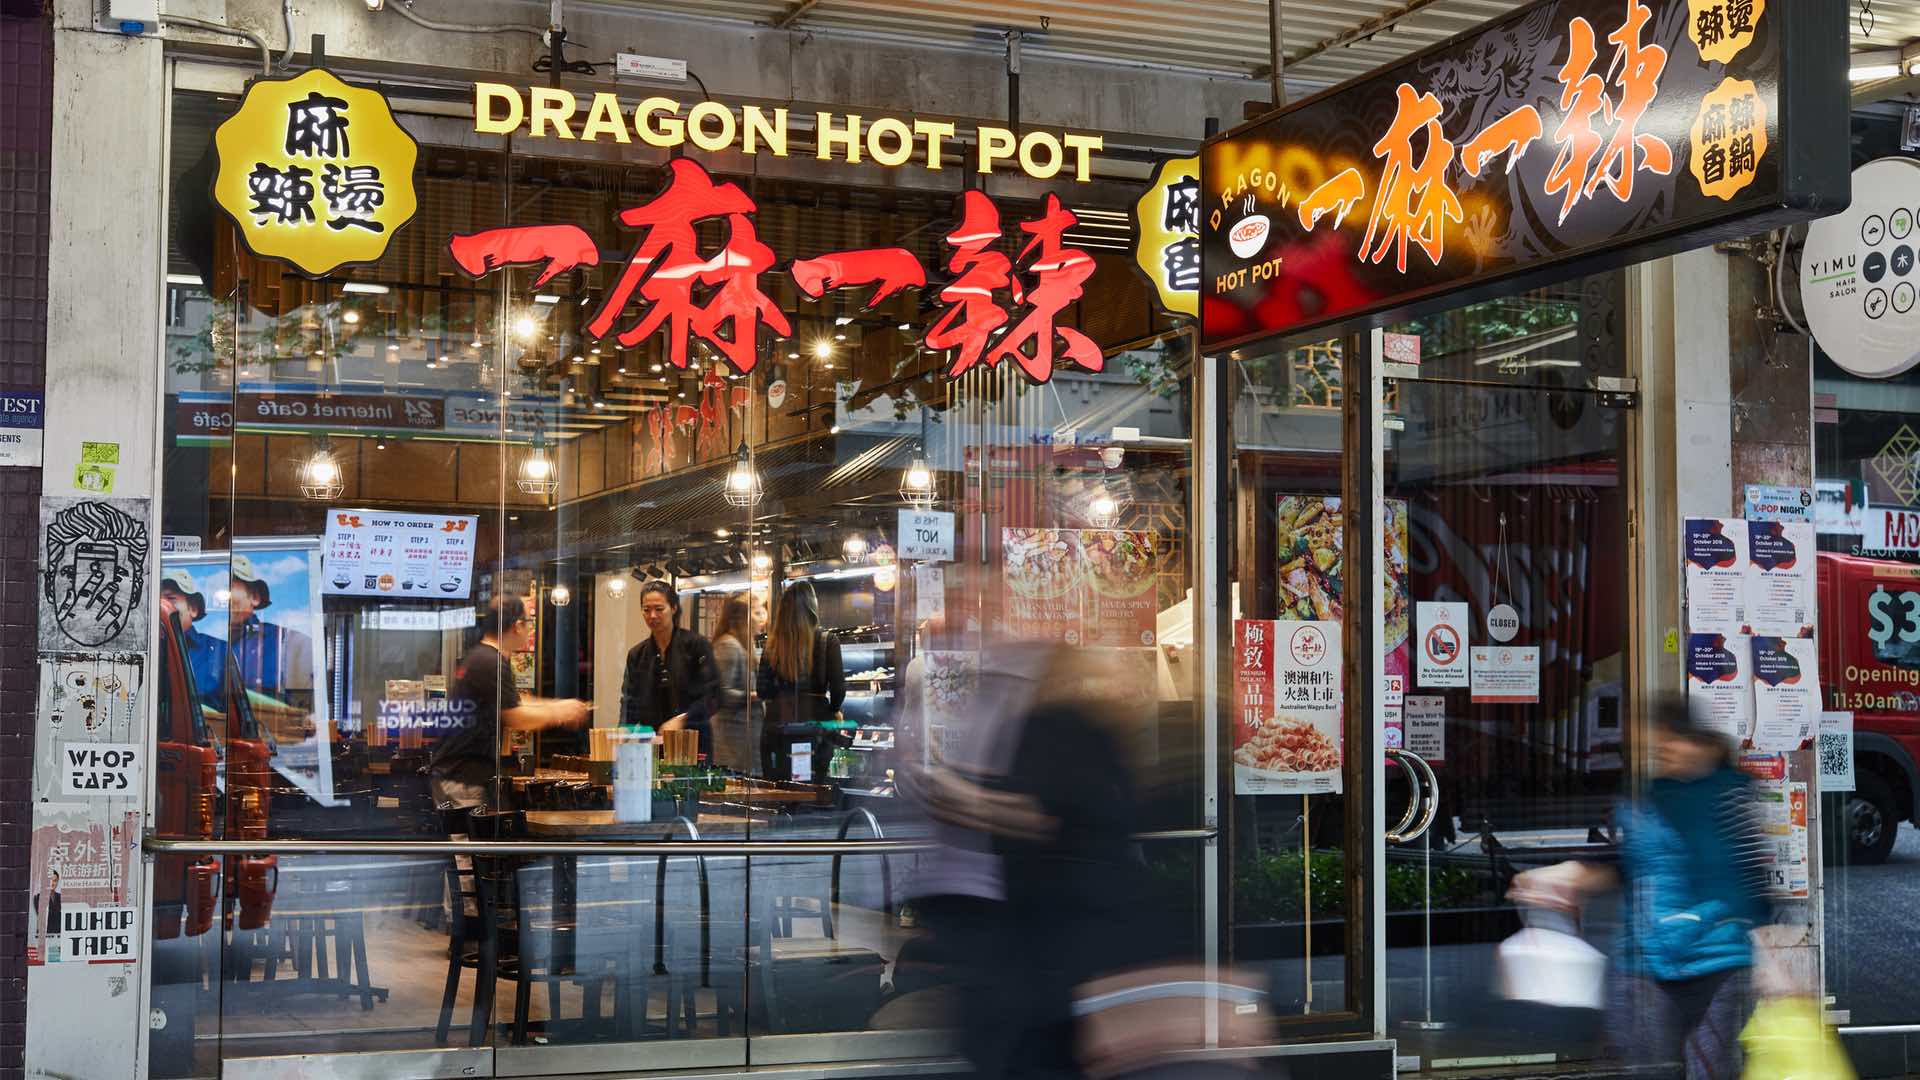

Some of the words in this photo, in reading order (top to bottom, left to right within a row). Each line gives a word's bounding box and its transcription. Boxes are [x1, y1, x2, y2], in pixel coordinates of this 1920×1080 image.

[285, 92, 349, 159] 麻
[474, 82, 787, 157] DRAGON
[816, 112, 955, 170] HOT
[977, 126, 1103, 183] POT
[1297, 0, 1674, 275] 一麻一辣
[1209, 168, 1291, 231] DRAGON
[450, 157, 1104, 384] 一麻一辣
[1811, 254, 1856, 276] YIMU
[1216, 268, 1247, 294] HOT
[1252, 258, 1283, 283] POT
[1836, 278, 1856, 288] HAIR
[1829, 287, 1857, 299] SALON
[0, 397, 40, 413] EST
[1780, 507, 1805, 515] NIGHT
[407, 521, 434, 529] ORDER
[338, 533, 352, 541] STEP
[410, 536, 423, 544] STEP
[1851, 544, 1897, 557] SALON
[1490, 619, 1517, 628] CLOSED
[1284, 670, 1334, 685] 澳洲和牛
[1846, 665, 1919, 686] Opening
[1284, 687, 1334, 702] 火熱上市
[1833, 692, 1902, 709] 11:30am
[68, 750, 135, 768] WHOP
[73, 772, 128, 789] TAPS
[65, 910, 134, 931] WHOP
[69, 936, 129, 956] TAPS
